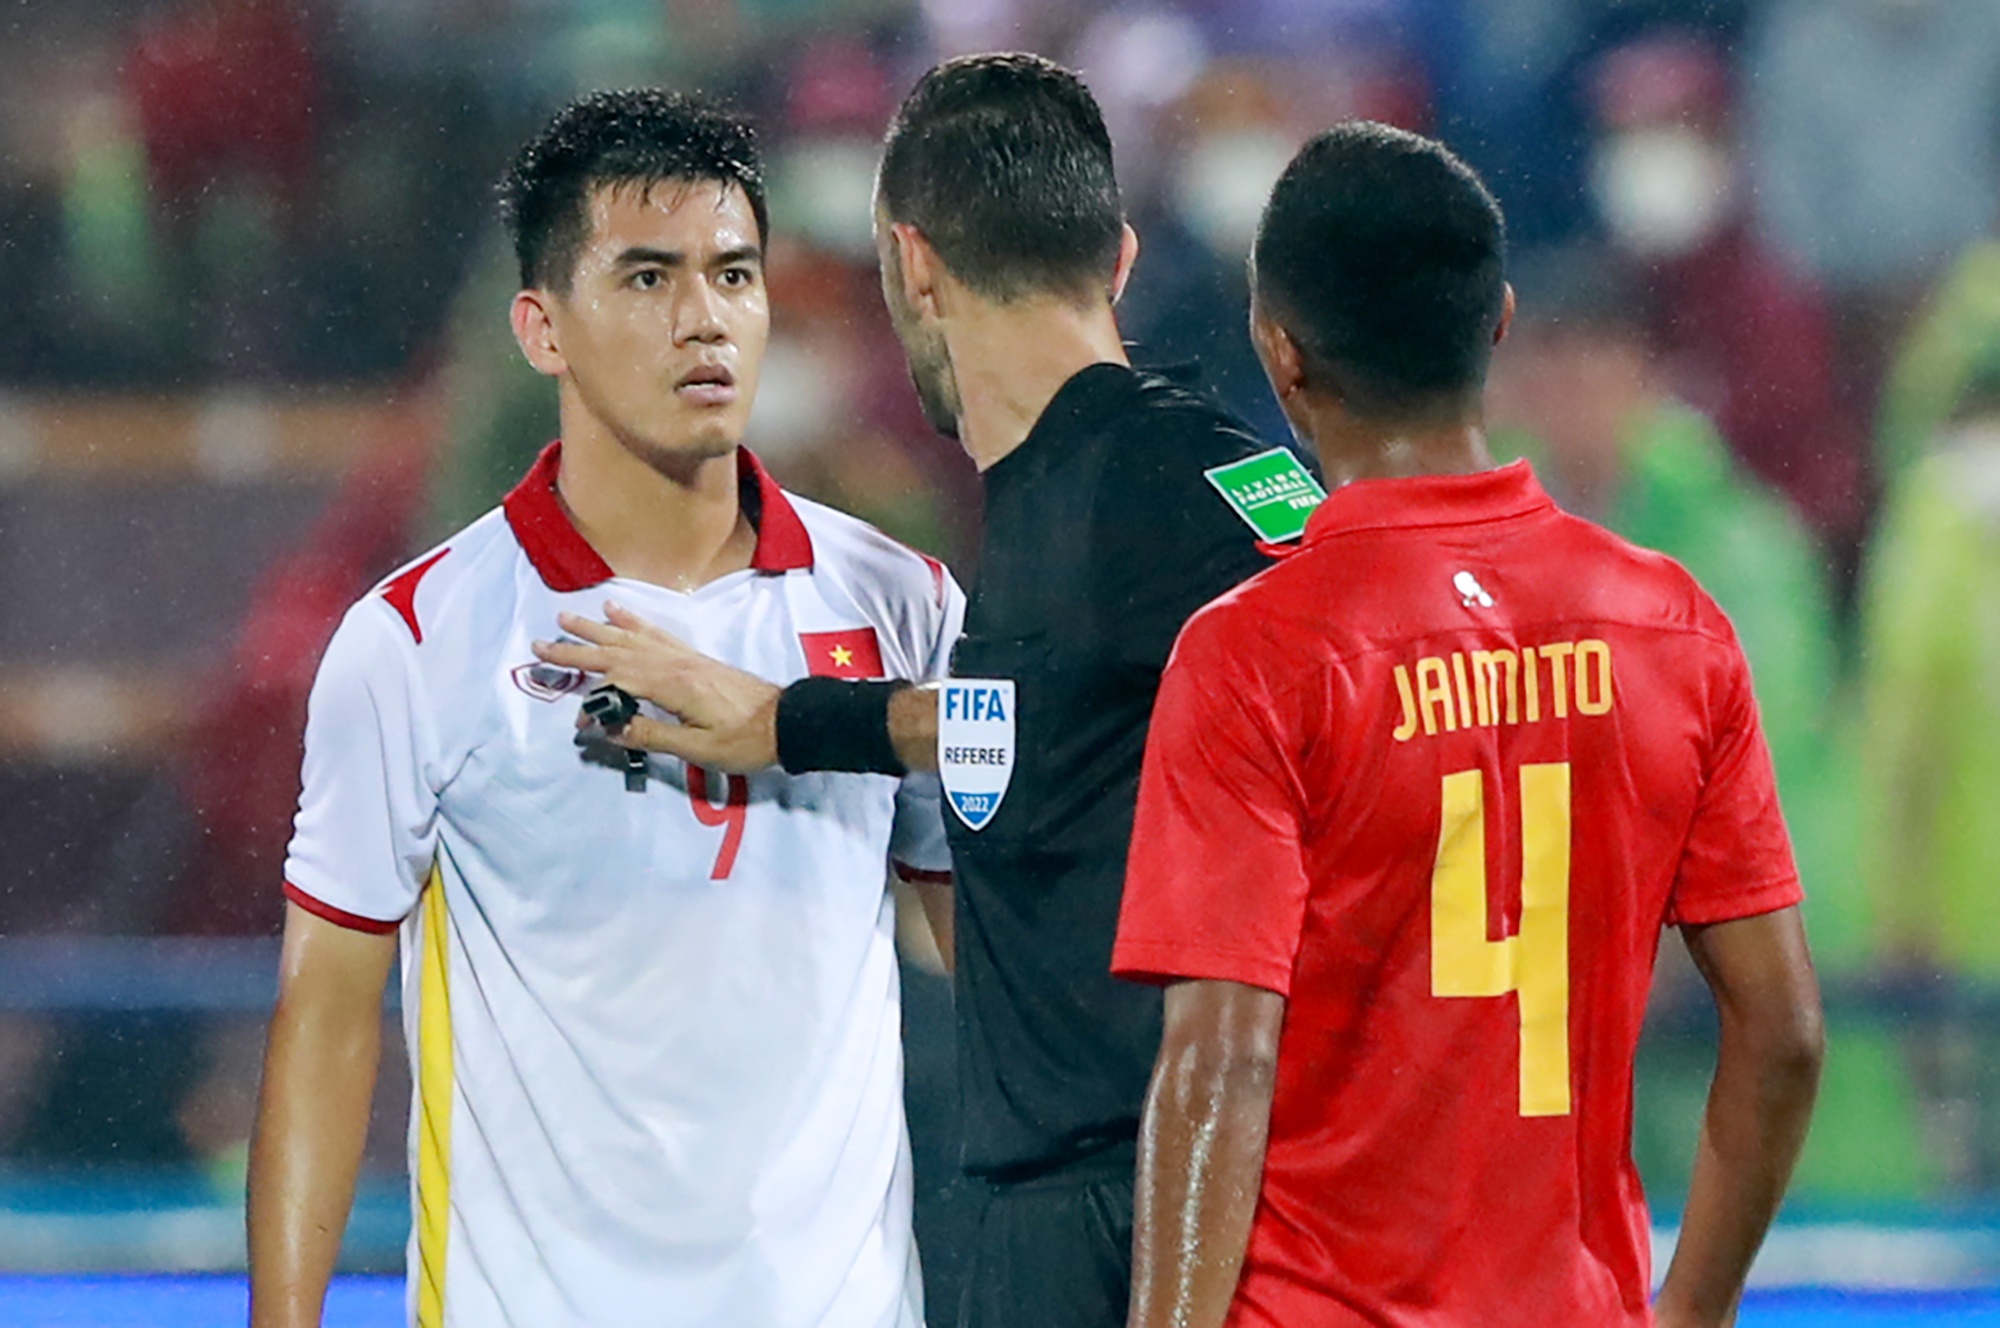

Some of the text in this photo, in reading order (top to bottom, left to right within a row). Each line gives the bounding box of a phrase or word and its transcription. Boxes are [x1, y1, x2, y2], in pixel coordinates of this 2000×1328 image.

[946, 687, 1006, 721] FIFA
[1393, 639, 1612, 741] JAIMITO
[945, 747, 1006, 765] REFEREE
[686, 763, 749, 880] 9
[961, 796, 990, 812] 2022
[1431, 762, 1570, 1117] 4
